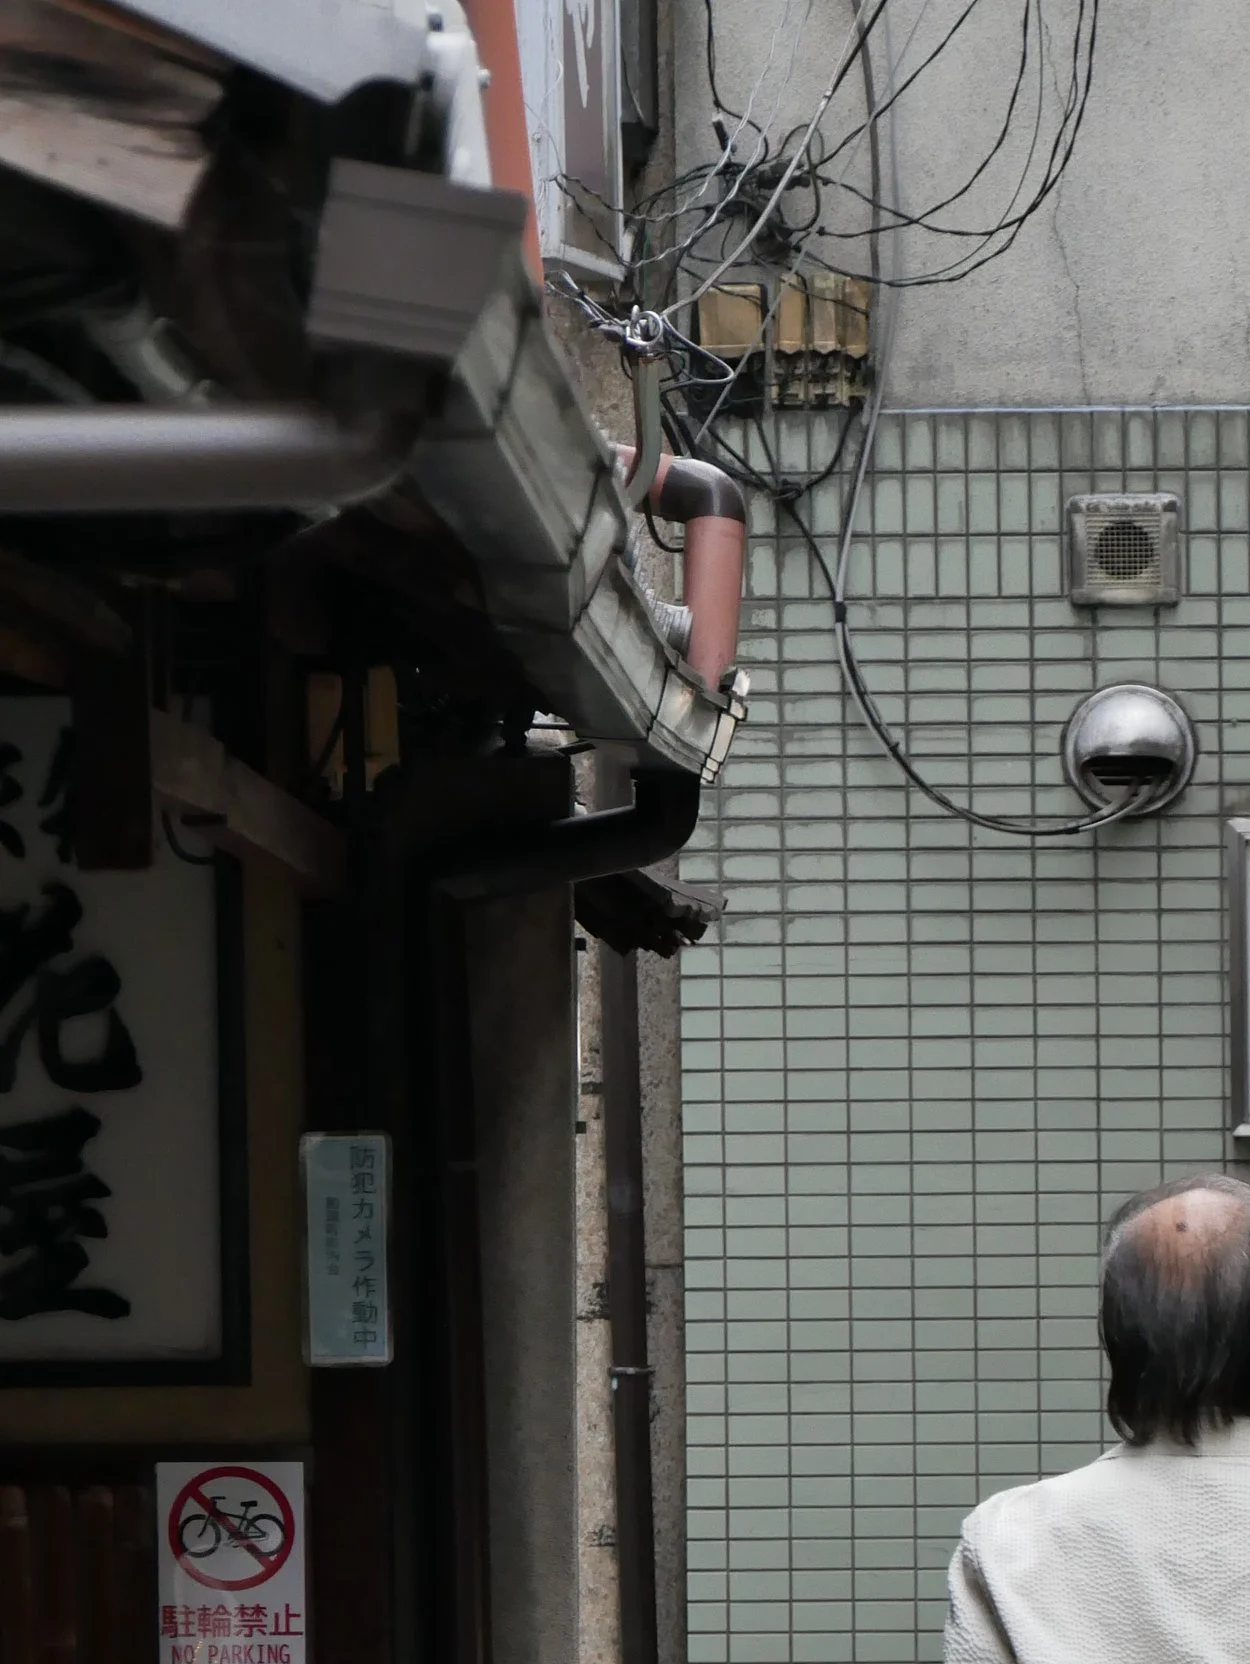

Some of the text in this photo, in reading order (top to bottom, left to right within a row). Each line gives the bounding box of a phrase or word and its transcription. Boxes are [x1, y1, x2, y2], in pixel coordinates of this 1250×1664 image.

[351, 1146, 378, 1349] 防犯カメラ作動中
[161, 1603, 304, 1638] 駐輪禁止
[171, 1645, 291, 1664] NO PARKING
